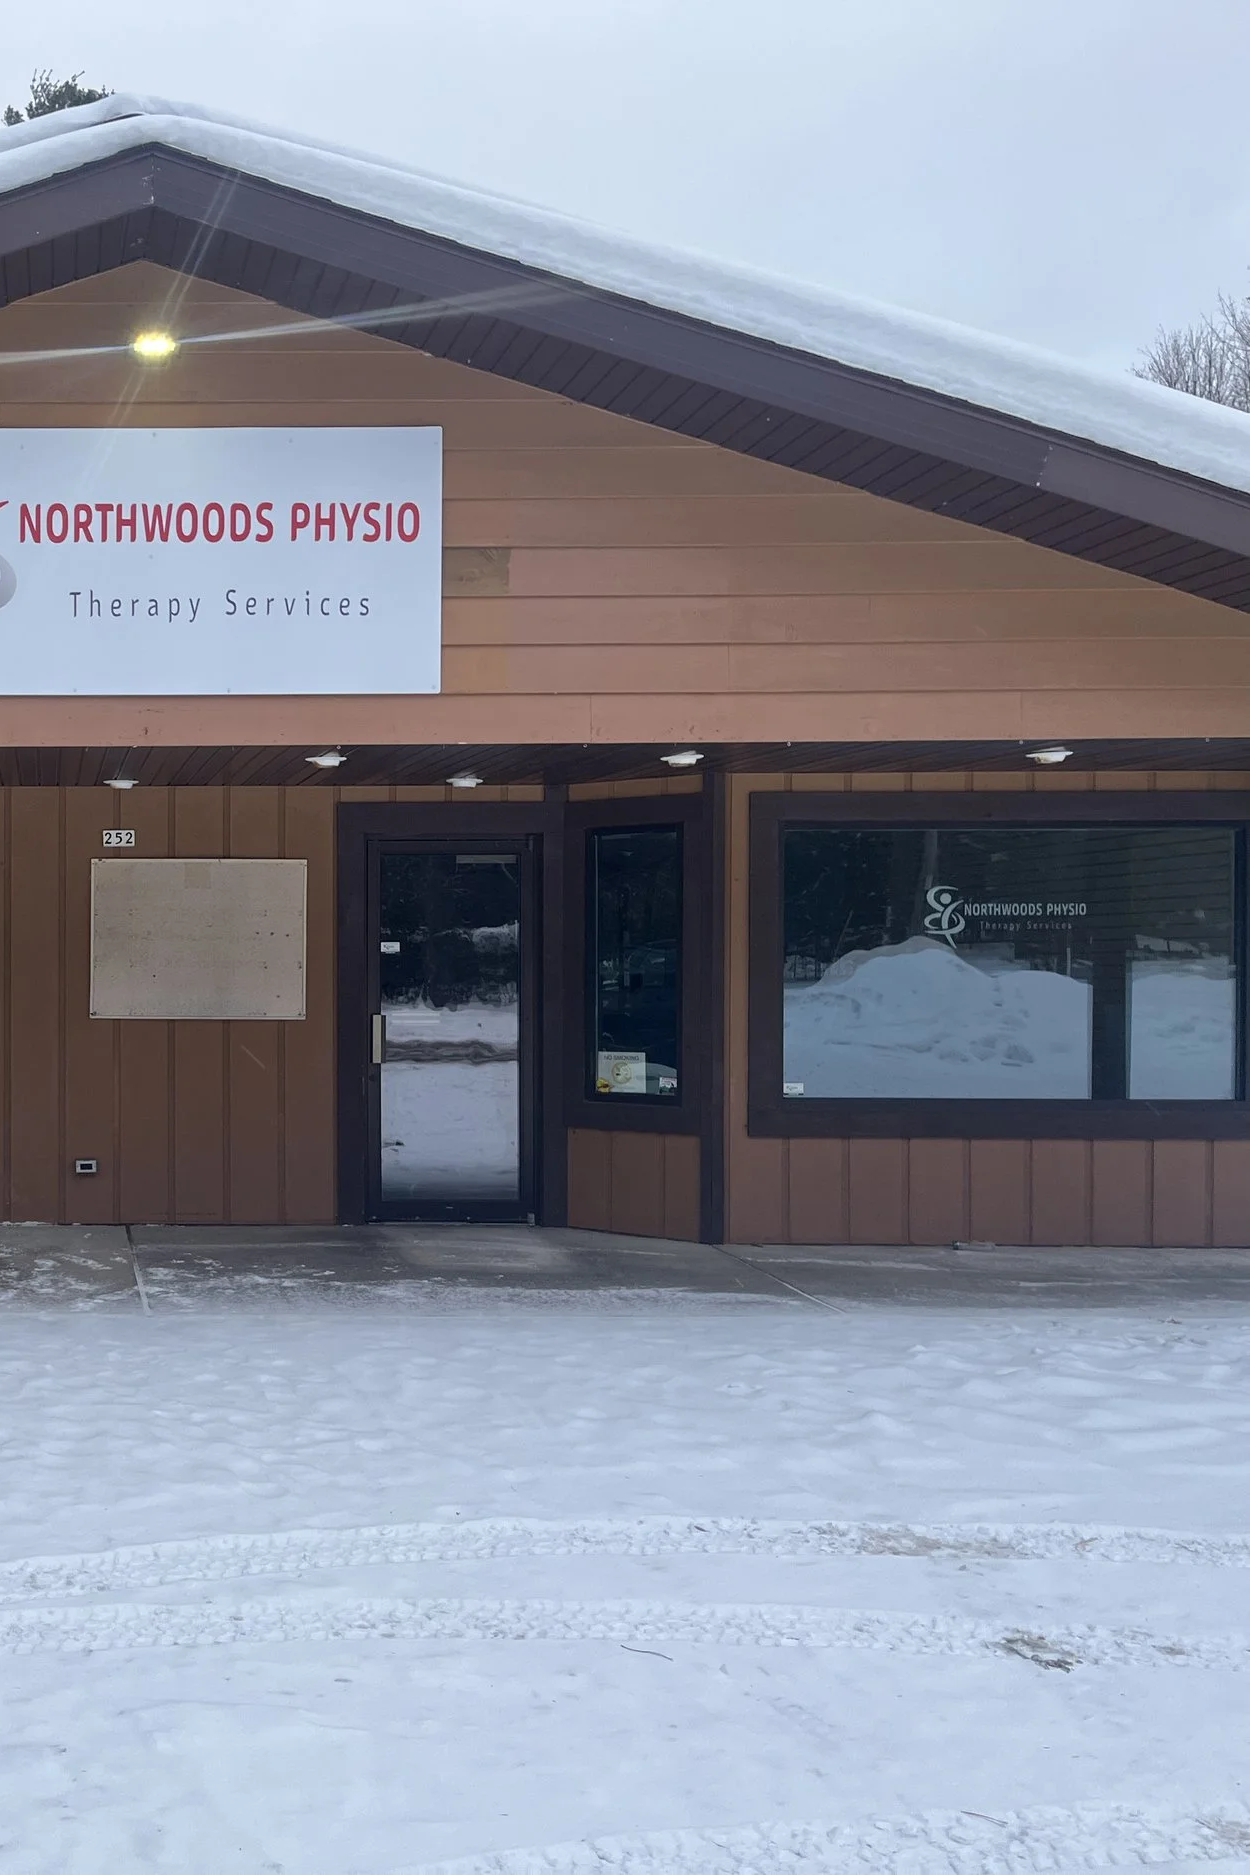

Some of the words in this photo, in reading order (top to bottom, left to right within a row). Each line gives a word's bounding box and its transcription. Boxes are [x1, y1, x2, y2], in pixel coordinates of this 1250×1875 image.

[19, 502, 275, 543] NORTHWOODS
[290, 502, 421, 543] PHYSIO
[69, 590, 202, 623] Therapy
[225, 589, 371, 617] Services
[104, 832, 132, 844] 252
[964, 903, 1042, 916] NORTHWOODS
[1046, 903, 1087, 916] PHYSIO
[979, 920, 1021, 931] Therapy
[1026, 920, 1072, 930] Services
